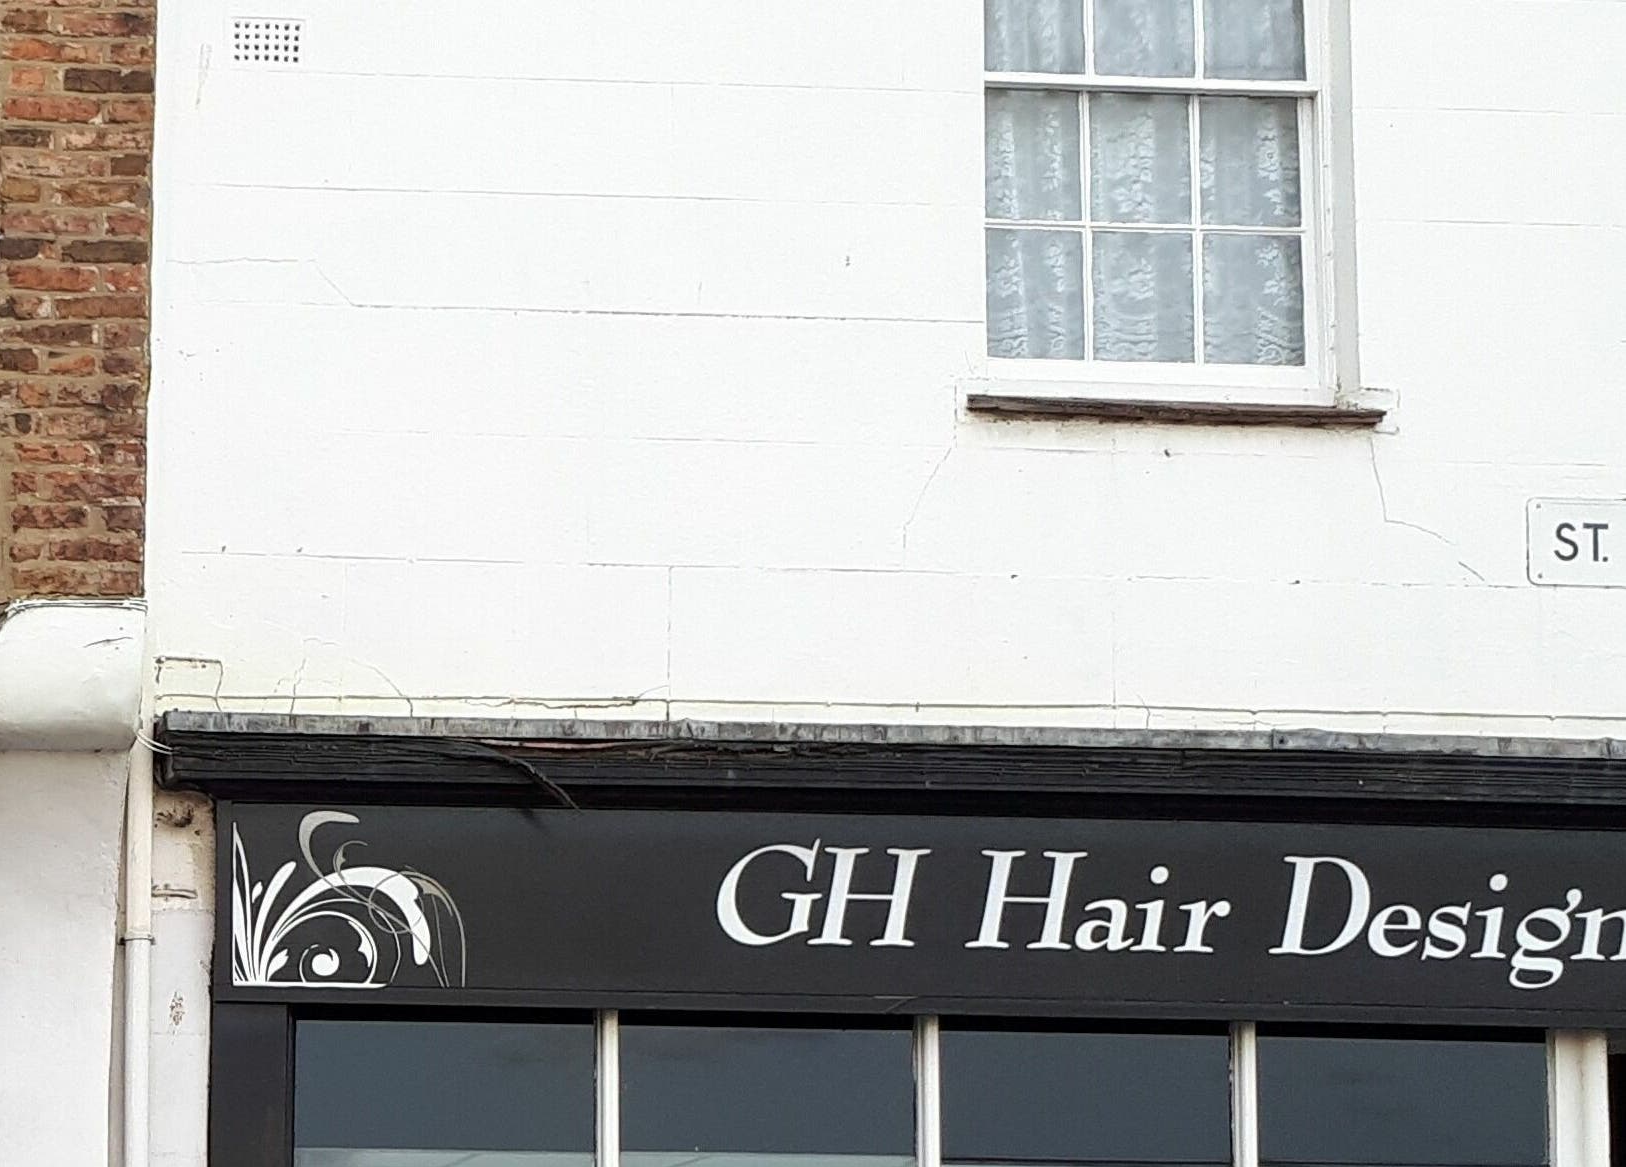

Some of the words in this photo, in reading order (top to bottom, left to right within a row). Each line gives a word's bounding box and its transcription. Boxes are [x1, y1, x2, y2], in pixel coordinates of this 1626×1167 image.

[1553, 522, 1609, 562] ST.
[715, 838, 931, 951] GH
[964, 848, 1232, 956] Hair
[1268, 854, 1626, 990] Design
